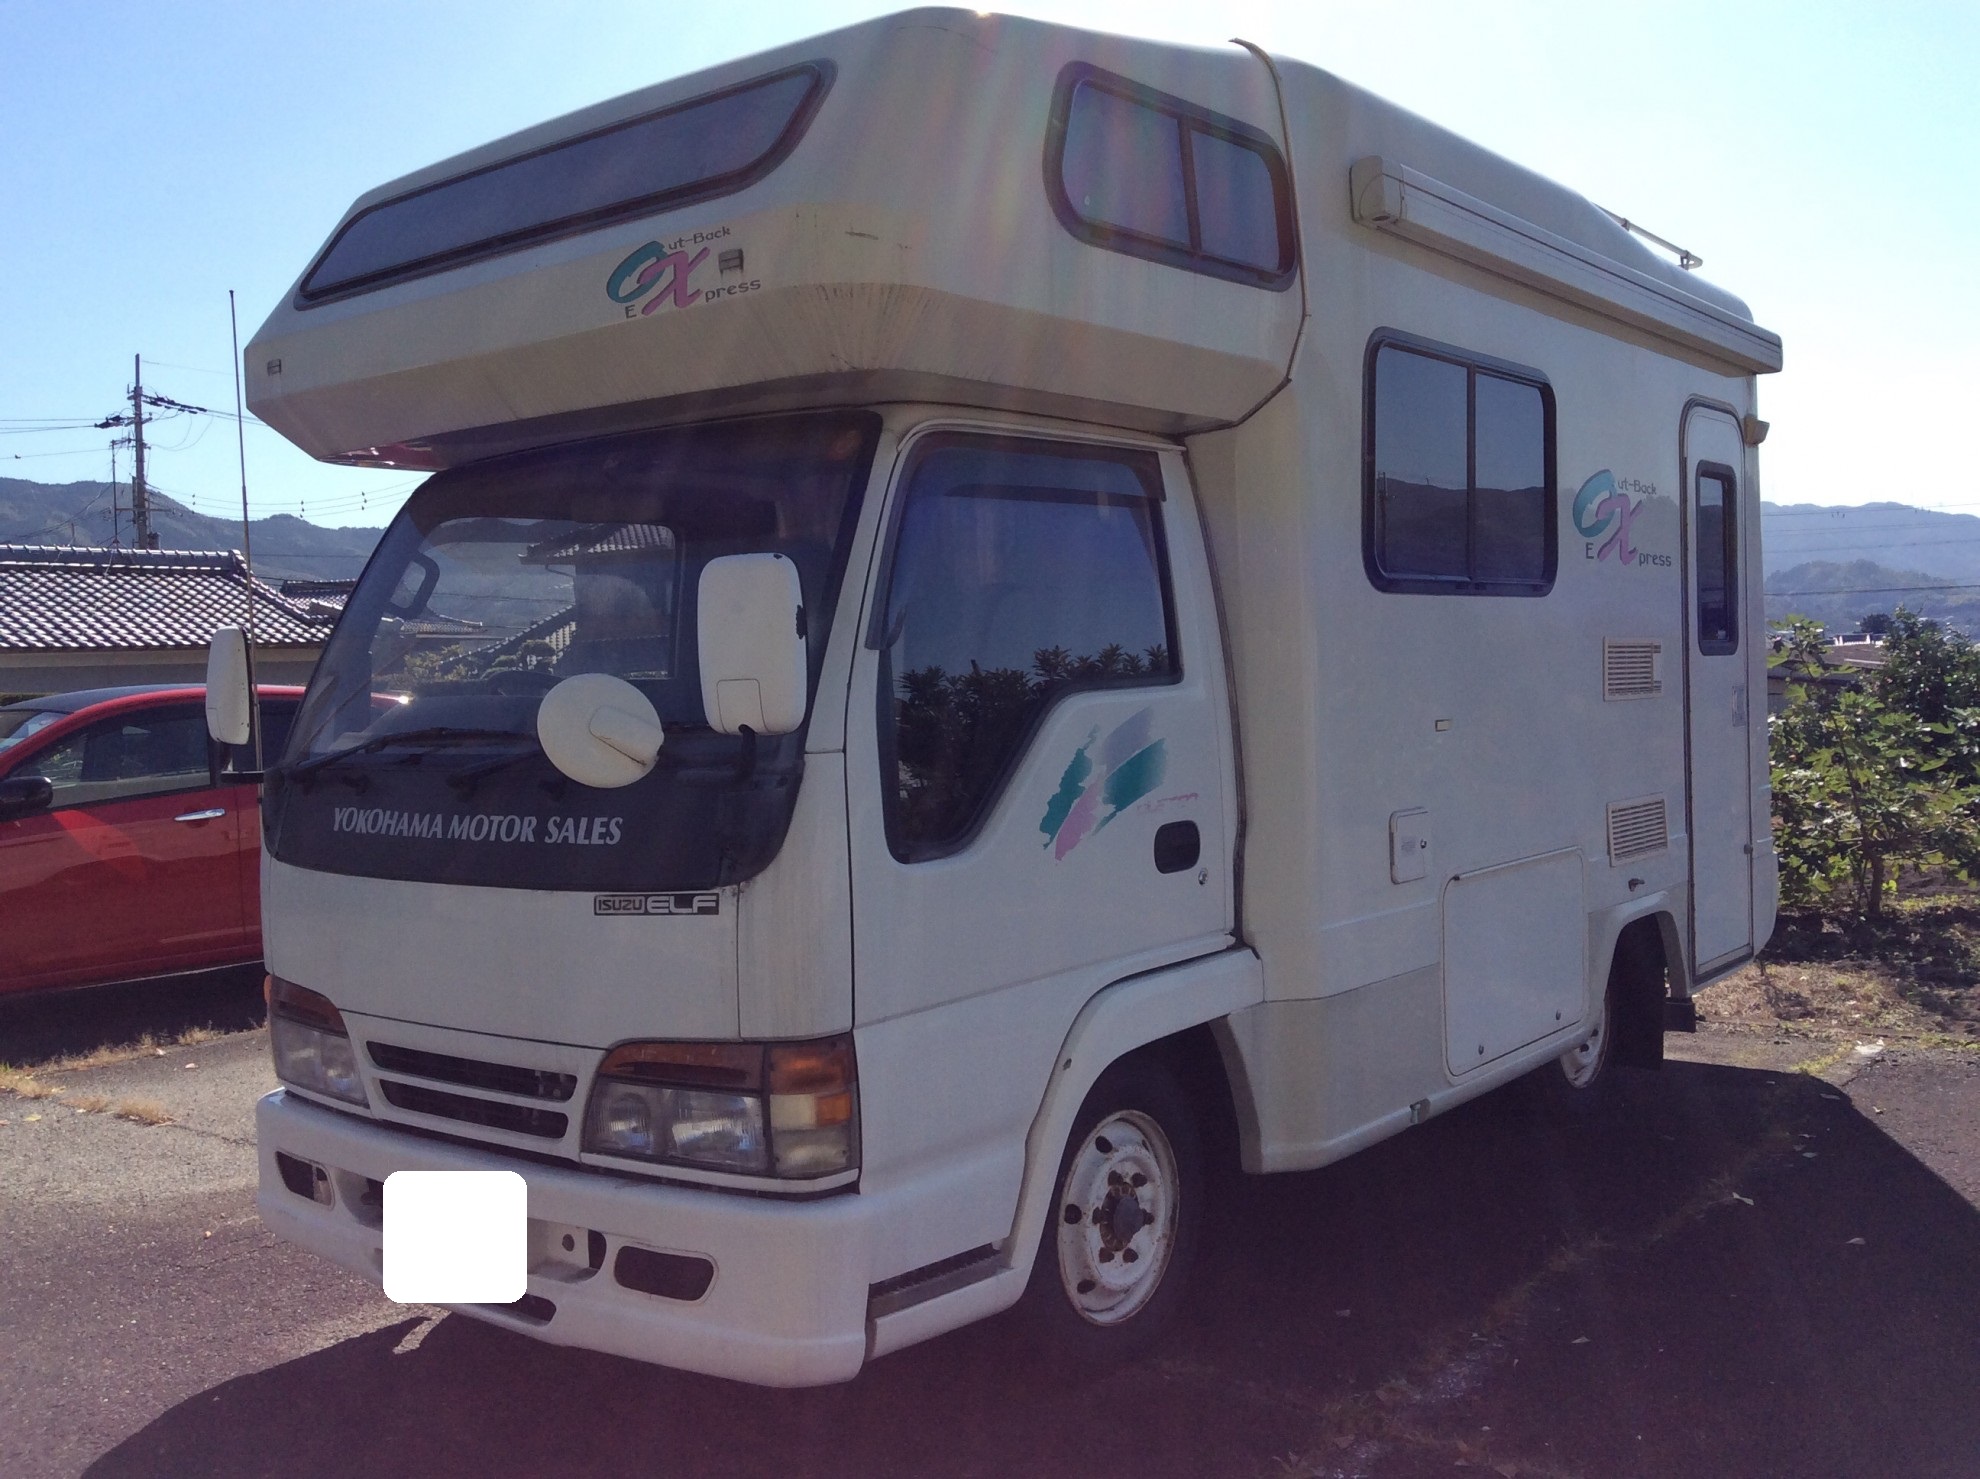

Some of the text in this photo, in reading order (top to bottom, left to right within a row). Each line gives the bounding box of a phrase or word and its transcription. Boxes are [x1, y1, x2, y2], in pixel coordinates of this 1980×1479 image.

[333, 807, 623, 845] YOKOHAMA MOTOR SALES
[598, 895, 718, 914] ISUZU ELF
